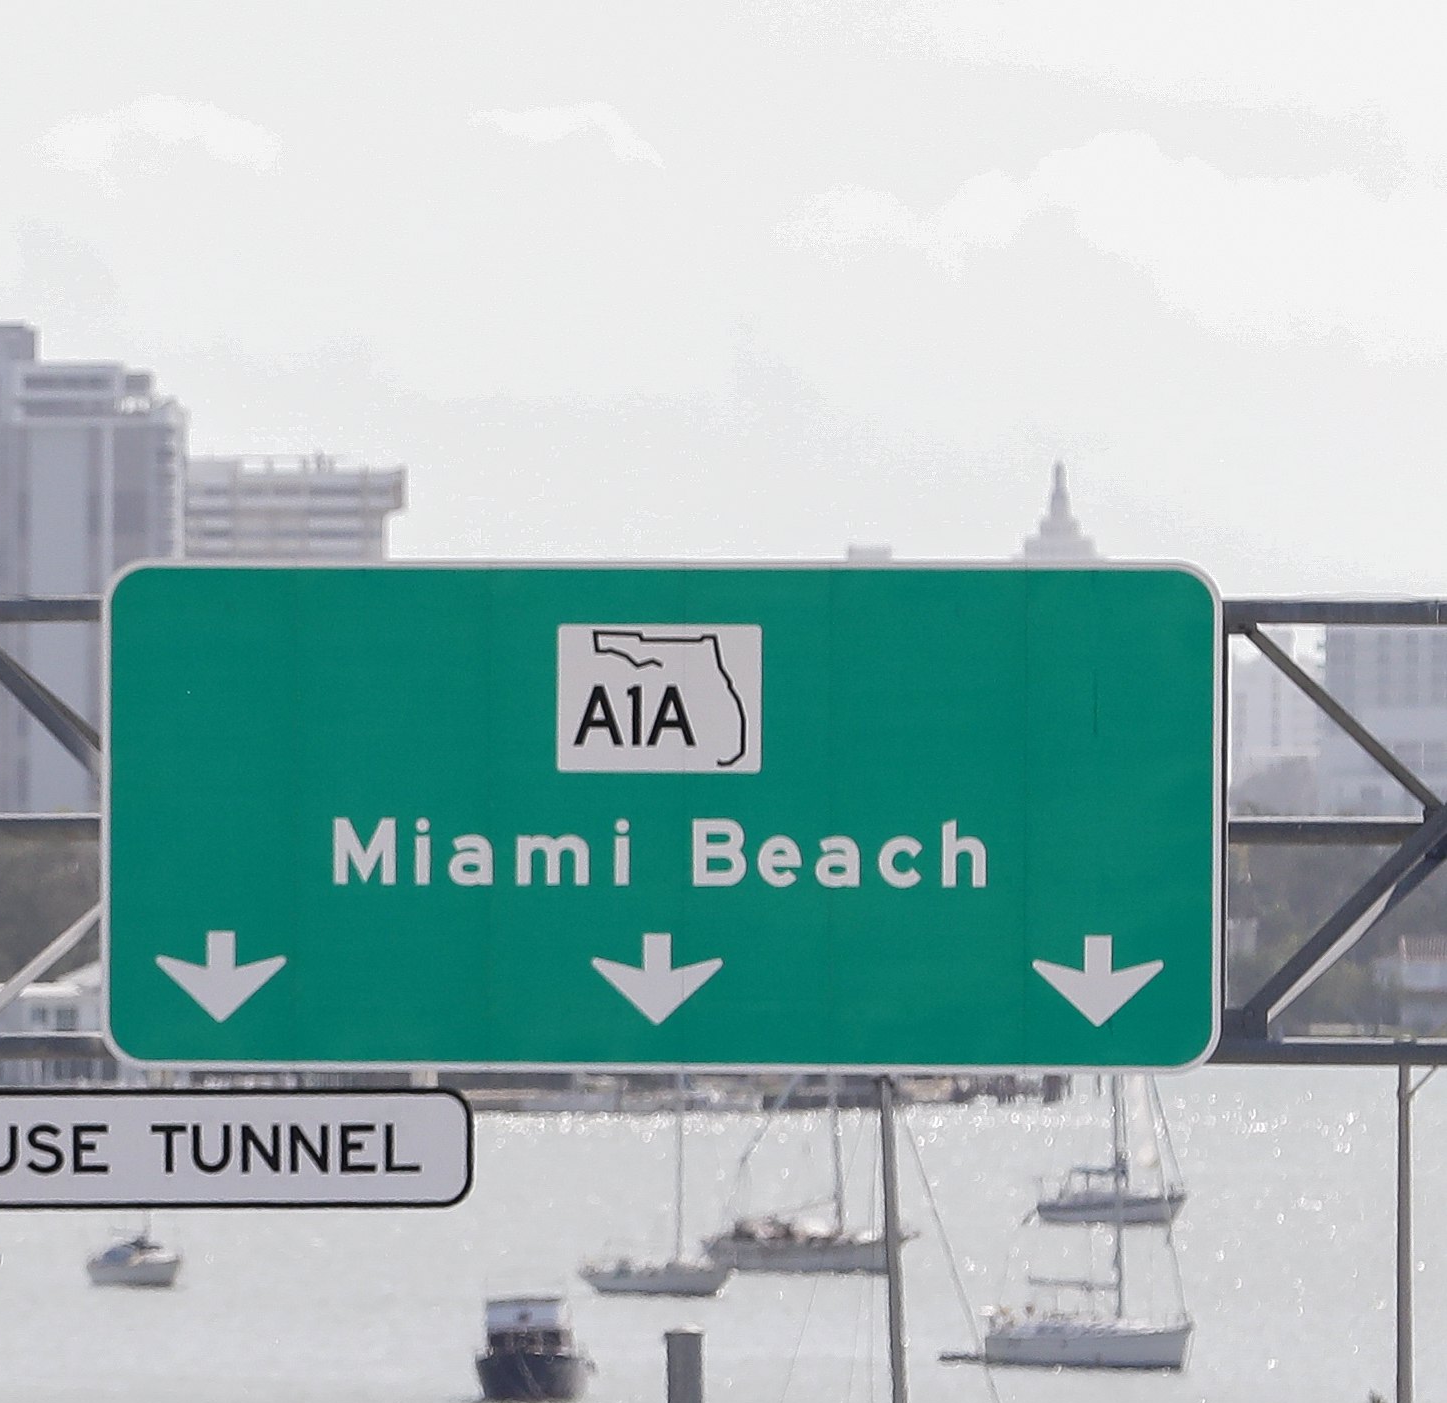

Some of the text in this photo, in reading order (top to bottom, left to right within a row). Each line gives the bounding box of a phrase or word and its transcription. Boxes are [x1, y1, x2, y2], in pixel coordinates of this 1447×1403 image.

[573, 685, 696, 747] A1A
[332, 818, 987, 888] Miami Beach
[150, 1123, 421, 1174] TUNNEL
